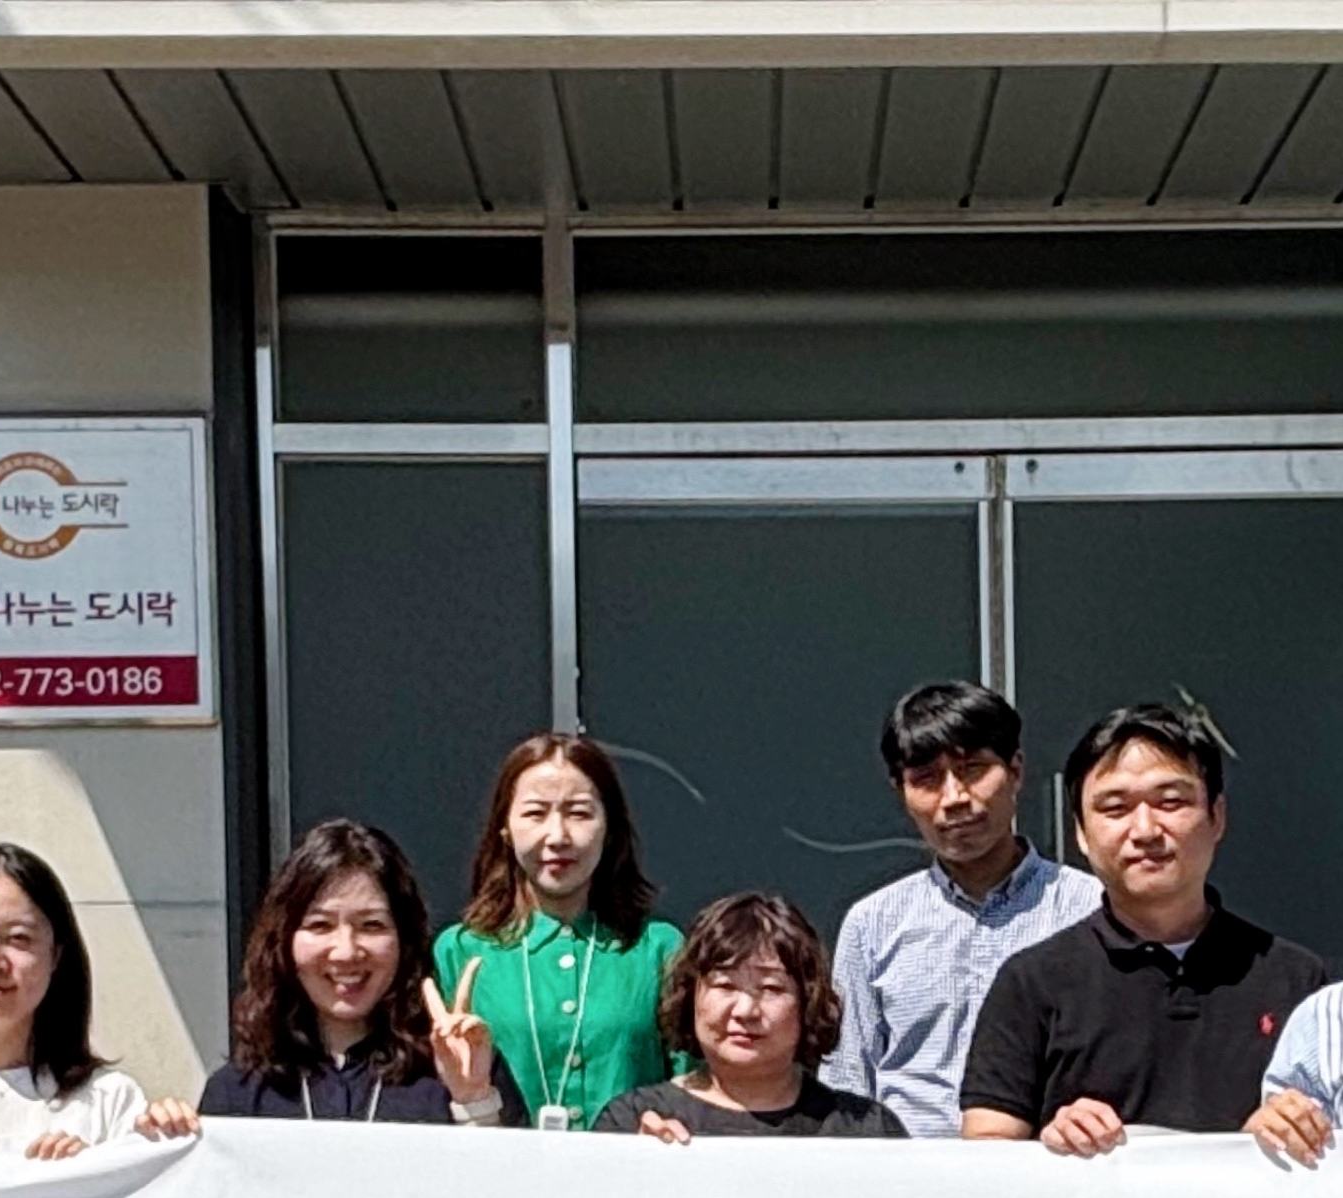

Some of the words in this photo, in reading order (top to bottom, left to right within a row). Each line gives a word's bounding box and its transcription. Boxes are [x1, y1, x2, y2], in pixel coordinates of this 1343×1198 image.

[2, 495, 55, 520] 나누는
[62, 493, 120, 518] 도시락
[86, 591, 177, 628] 도시락
